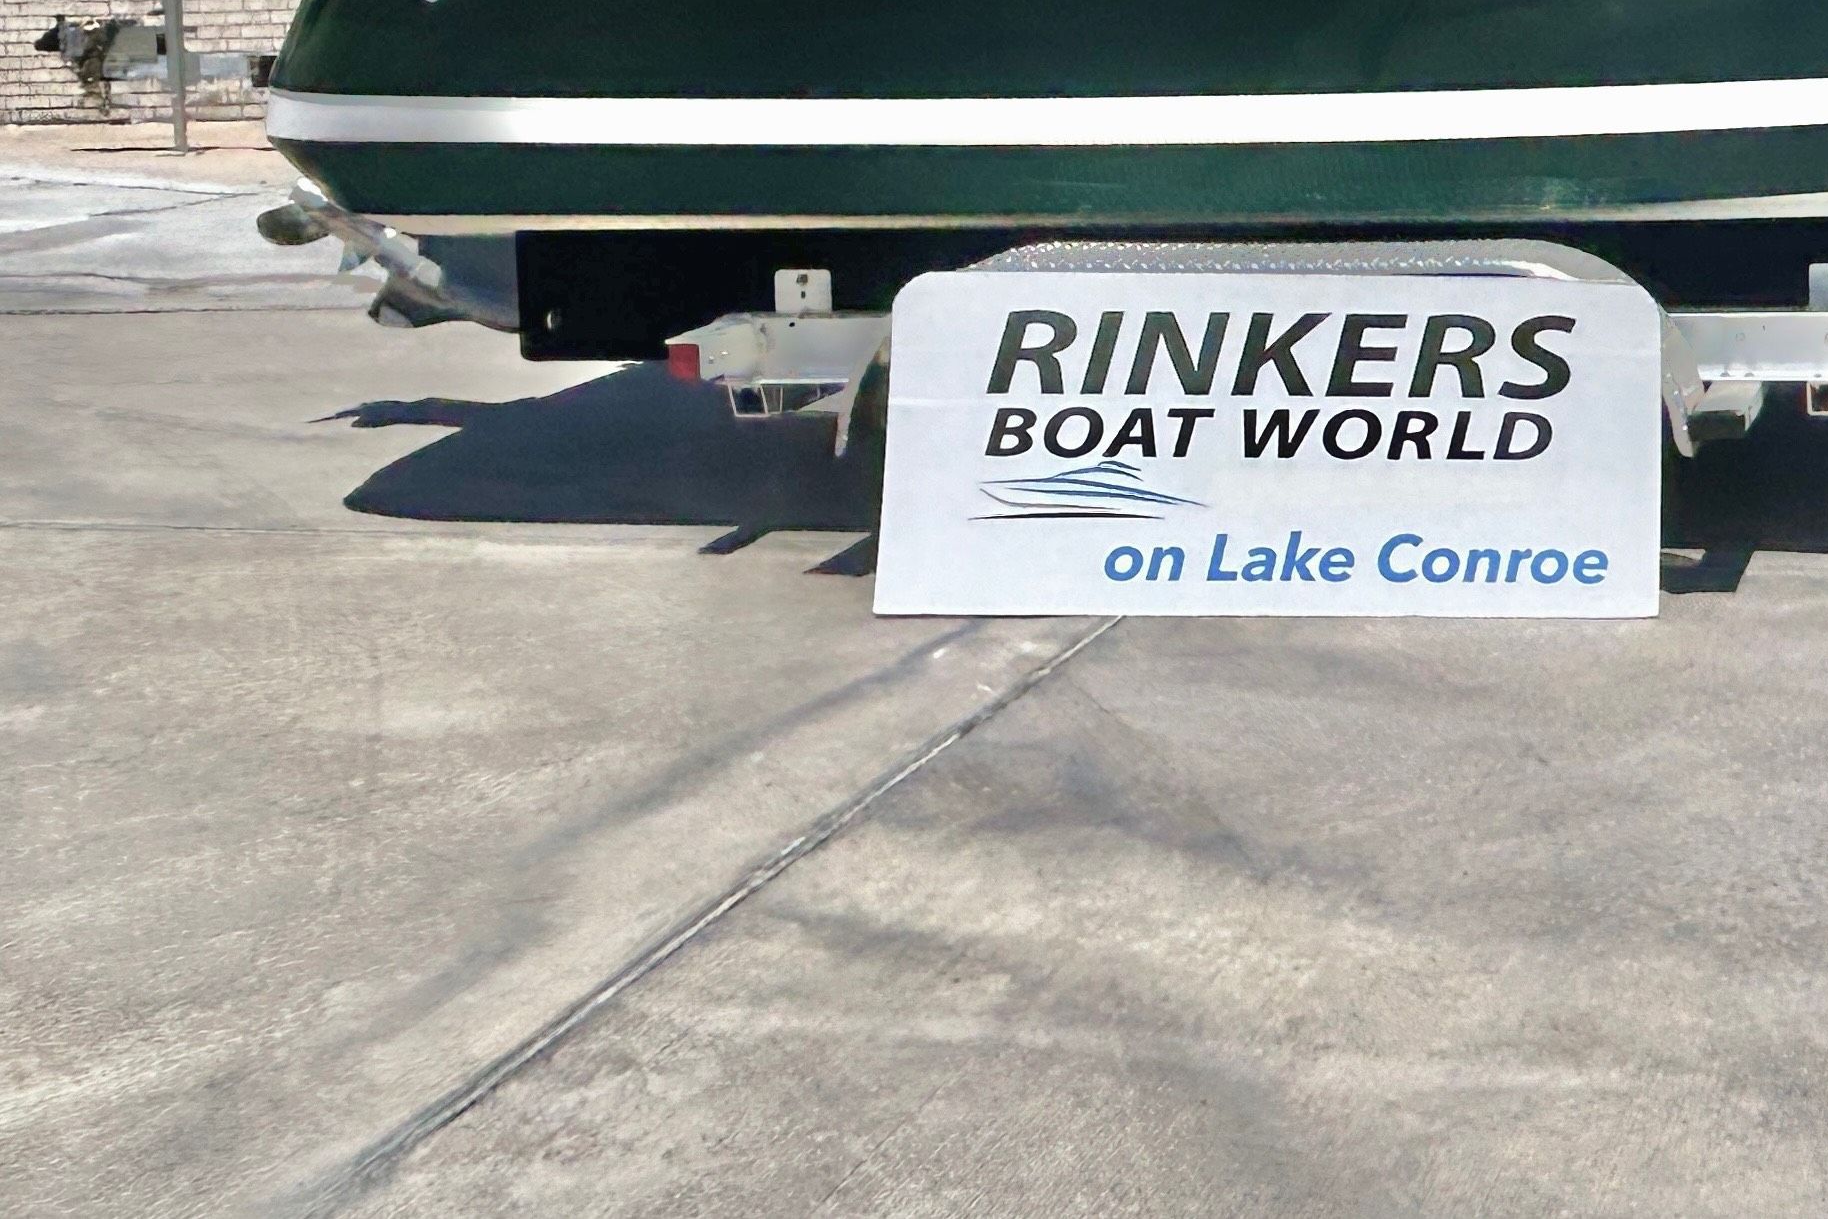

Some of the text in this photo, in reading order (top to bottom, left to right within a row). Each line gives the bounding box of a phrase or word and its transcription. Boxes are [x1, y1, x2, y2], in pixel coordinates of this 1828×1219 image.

[986, 309, 1577, 400] RINKERS
[984, 407, 1554, 461] BOAT WORLD
[1103, 530, 1610, 584] on Lake Conroe
